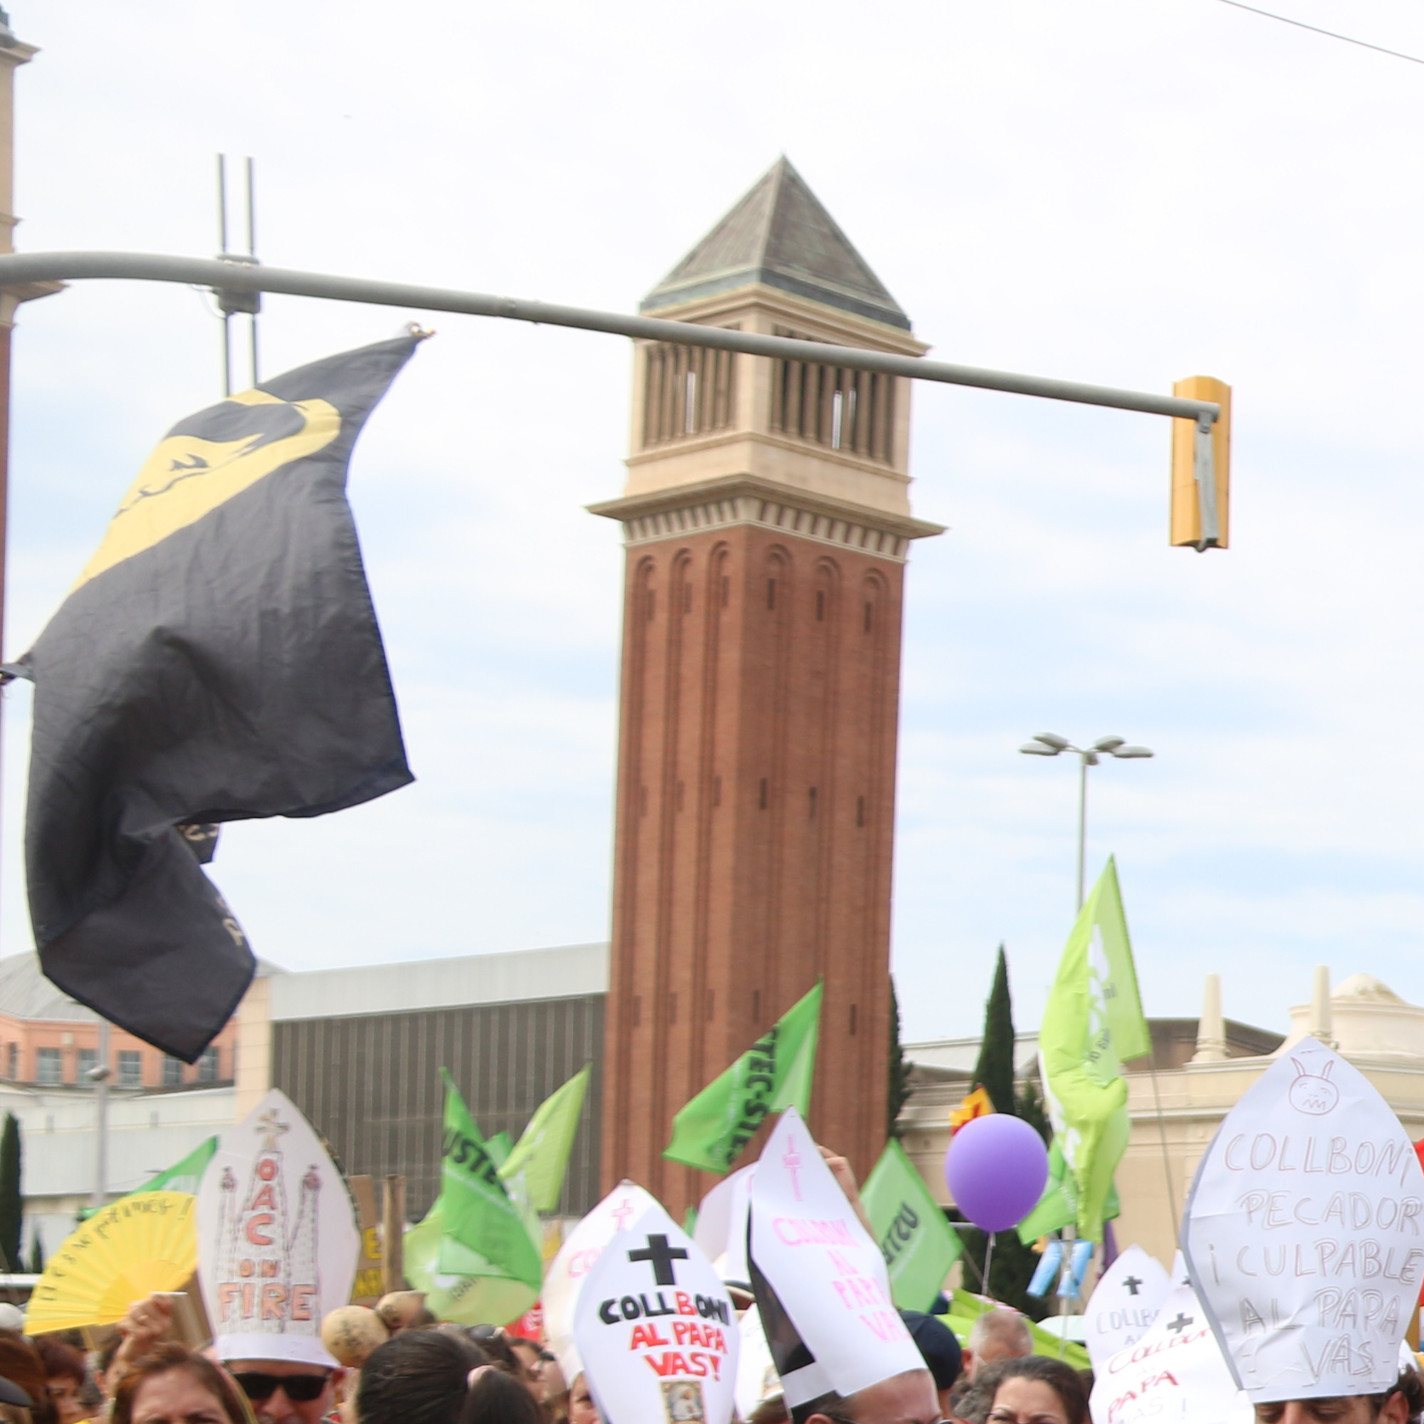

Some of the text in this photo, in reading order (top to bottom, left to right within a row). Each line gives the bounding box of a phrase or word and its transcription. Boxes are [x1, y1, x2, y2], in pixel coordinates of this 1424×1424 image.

[1236, 1188, 1424, 1236] PECADOR
[1236, 1239, 1424, 1286] CULPABLE
[218, 1282, 316, 1322] FIRE
[1242, 1297, 1298, 1334] AL
[1313, 1286, 1401, 1336] PAPA
[629, 1321, 727, 1354] AL PAPA
[643, 1351, 721, 1381] VAS!
[1107, 1370, 1179, 1424] PAPA
